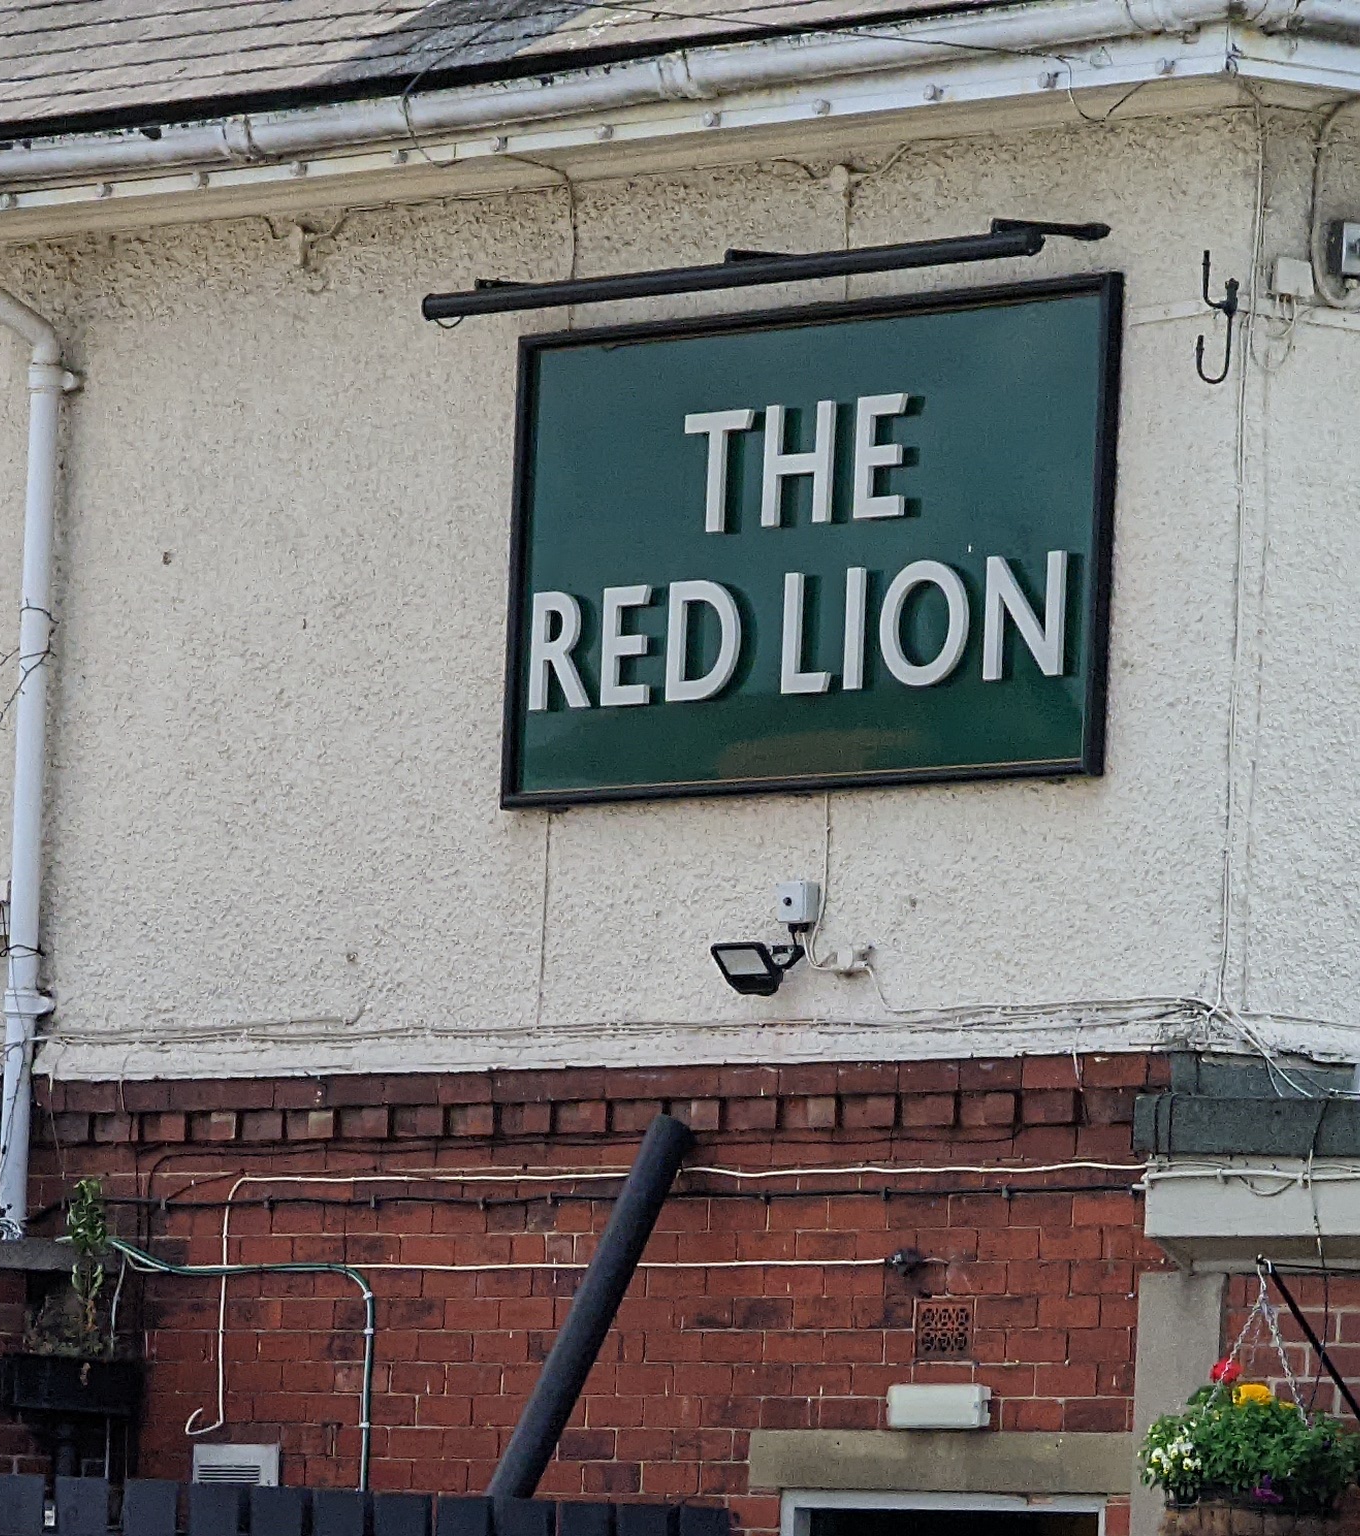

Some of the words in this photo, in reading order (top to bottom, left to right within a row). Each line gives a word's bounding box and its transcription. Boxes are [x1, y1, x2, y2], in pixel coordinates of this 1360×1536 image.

[683, 392, 910, 534] THE
[527, 579, 742, 712] RED
[780, 549, 1069, 695] LION
